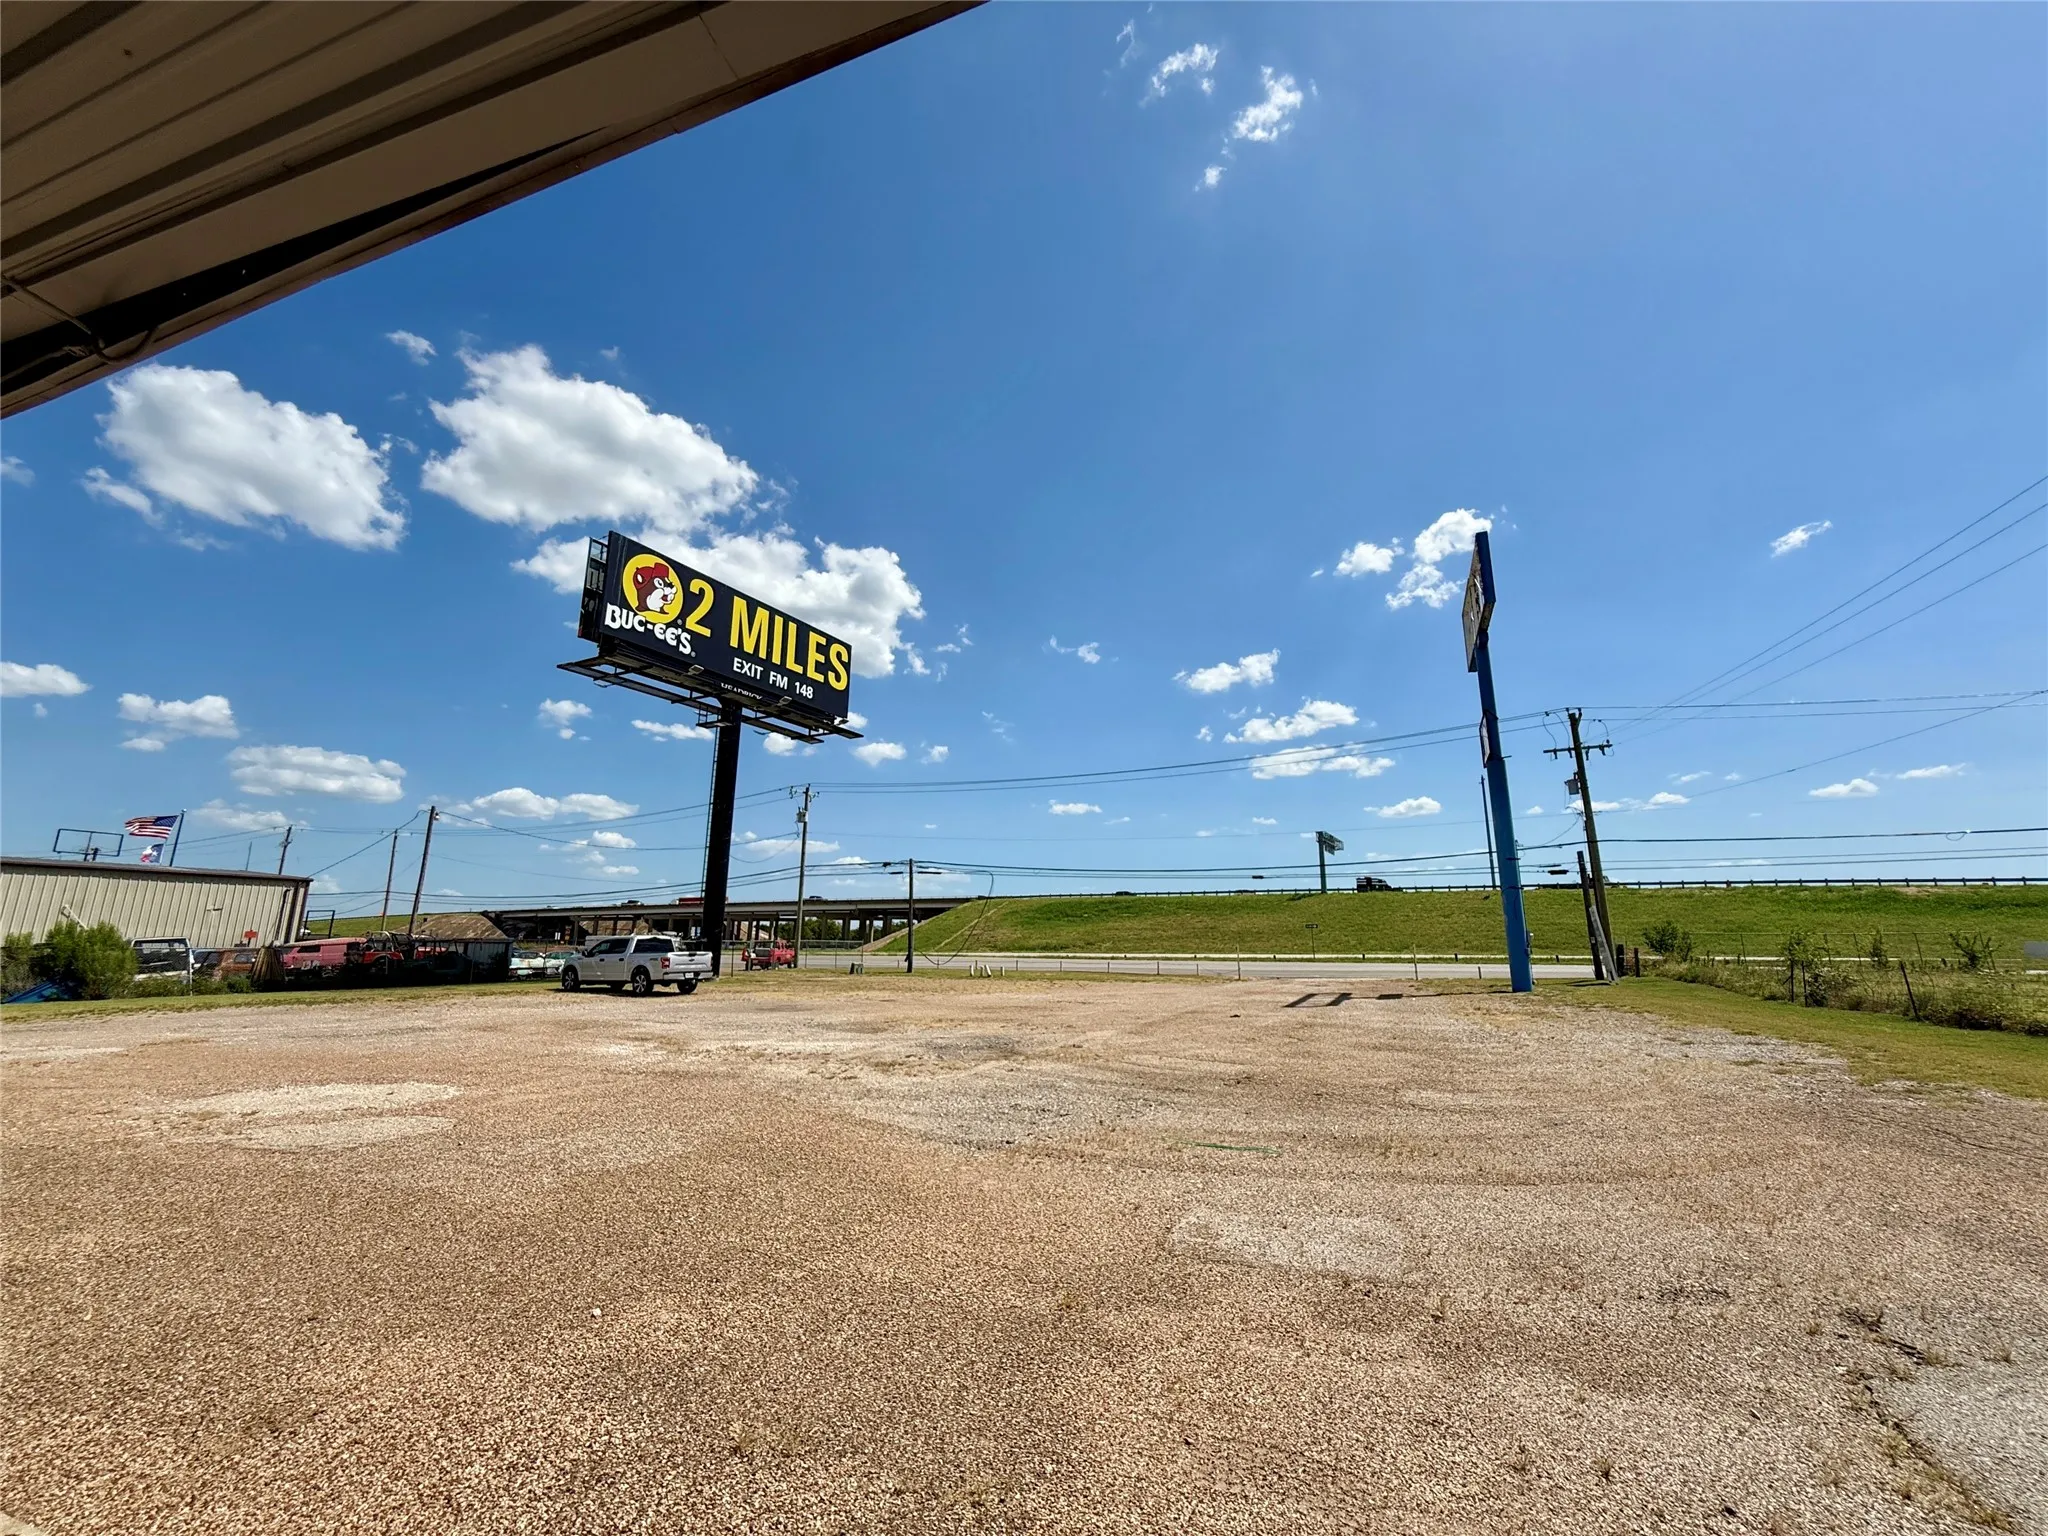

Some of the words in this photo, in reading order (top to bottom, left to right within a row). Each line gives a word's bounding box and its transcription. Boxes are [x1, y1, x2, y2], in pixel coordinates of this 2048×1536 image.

[685, 578, 715, 637] 2
[729, 595, 849, 691] MILES
[733, 657, 764, 680] EXIT
[769, 671, 789, 690] FM
[794, 681, 814, 699] 148
